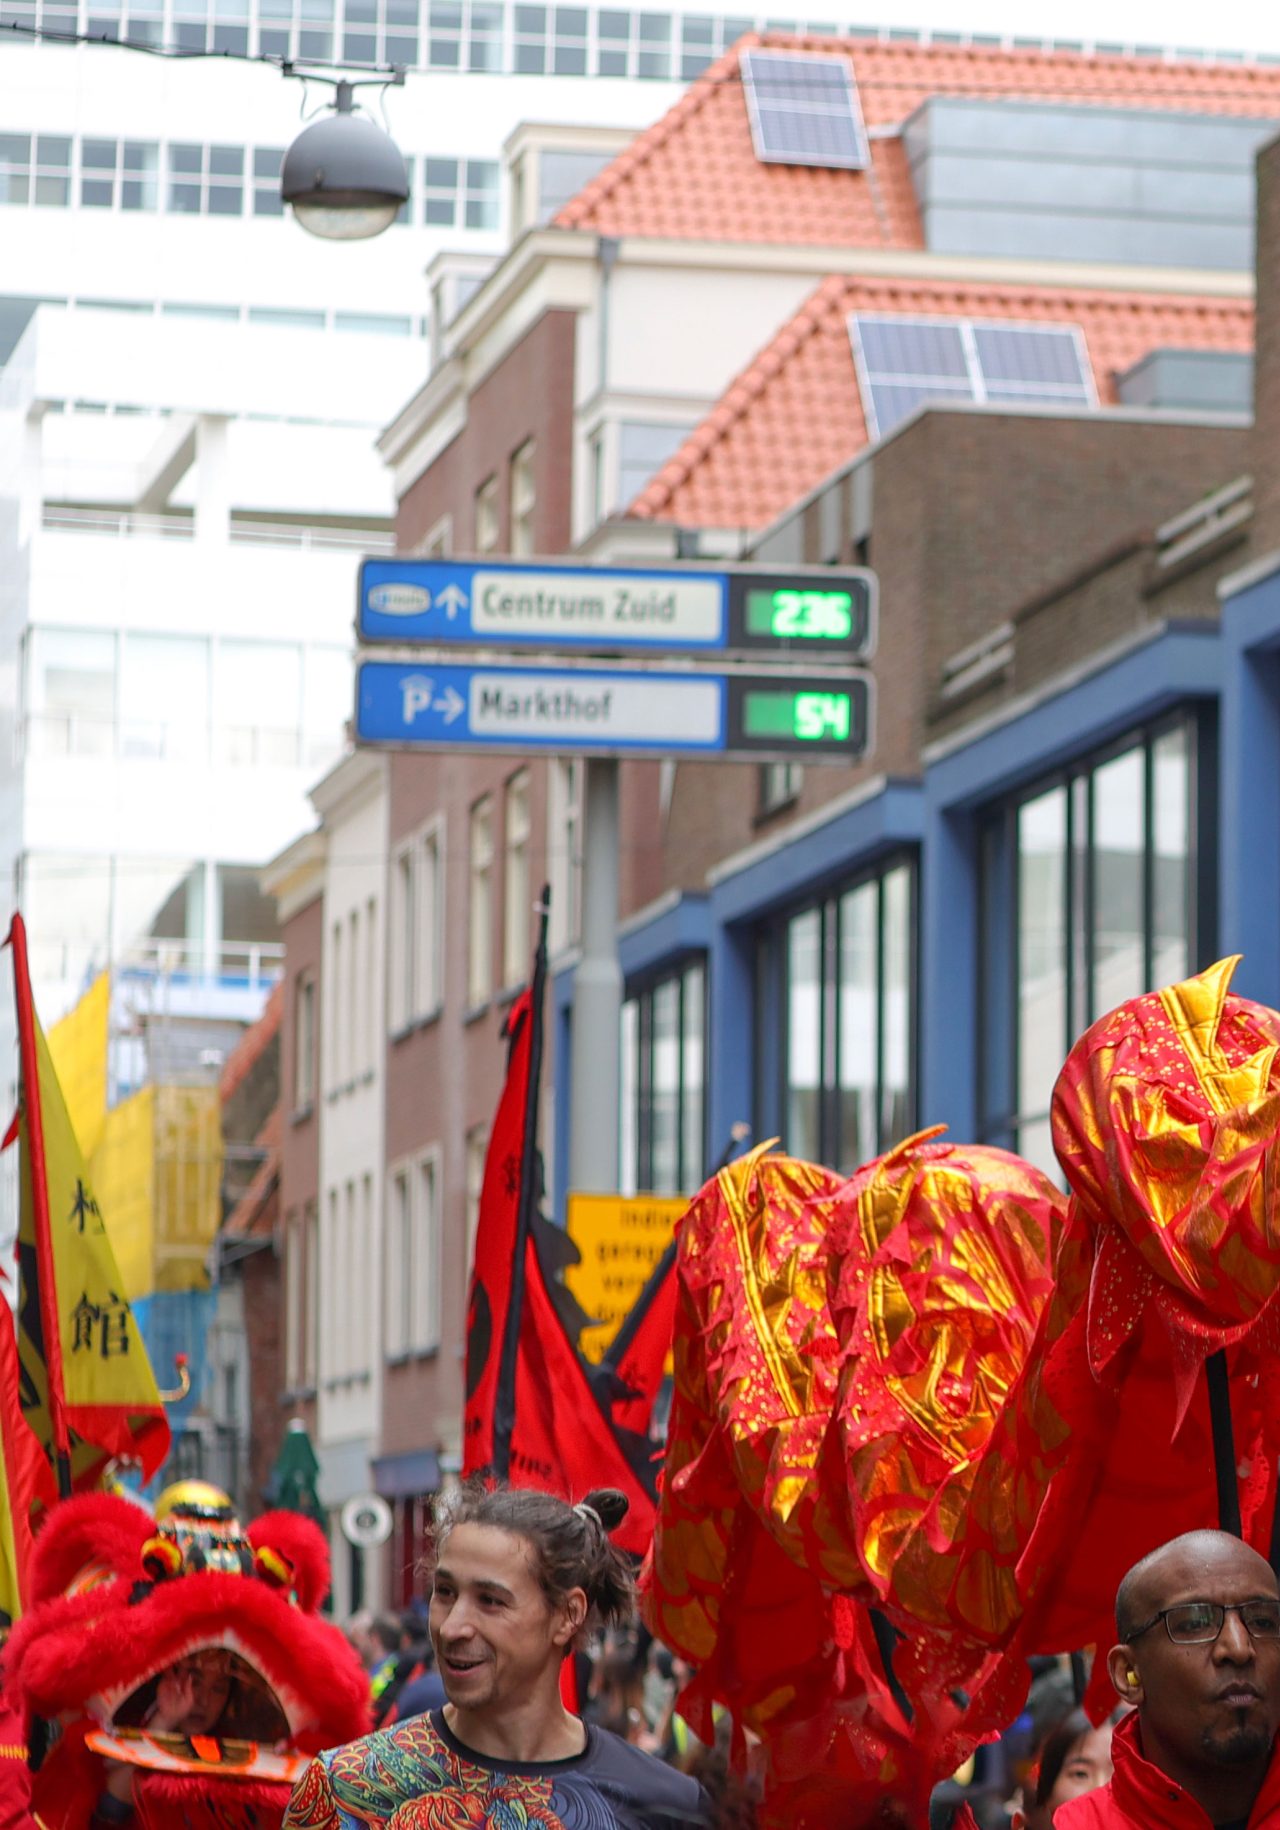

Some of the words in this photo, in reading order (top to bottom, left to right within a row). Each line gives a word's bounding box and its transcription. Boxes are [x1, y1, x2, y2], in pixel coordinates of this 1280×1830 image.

[481, 583, 604, 620] Centrum
[613, 588, 677, 623] Zuid
[771, 588, 852, 640] 236
[402, 687, 431, 724] P
[480, 685, 613, 722] Markthof
[793, 691, 850, 741] 54
